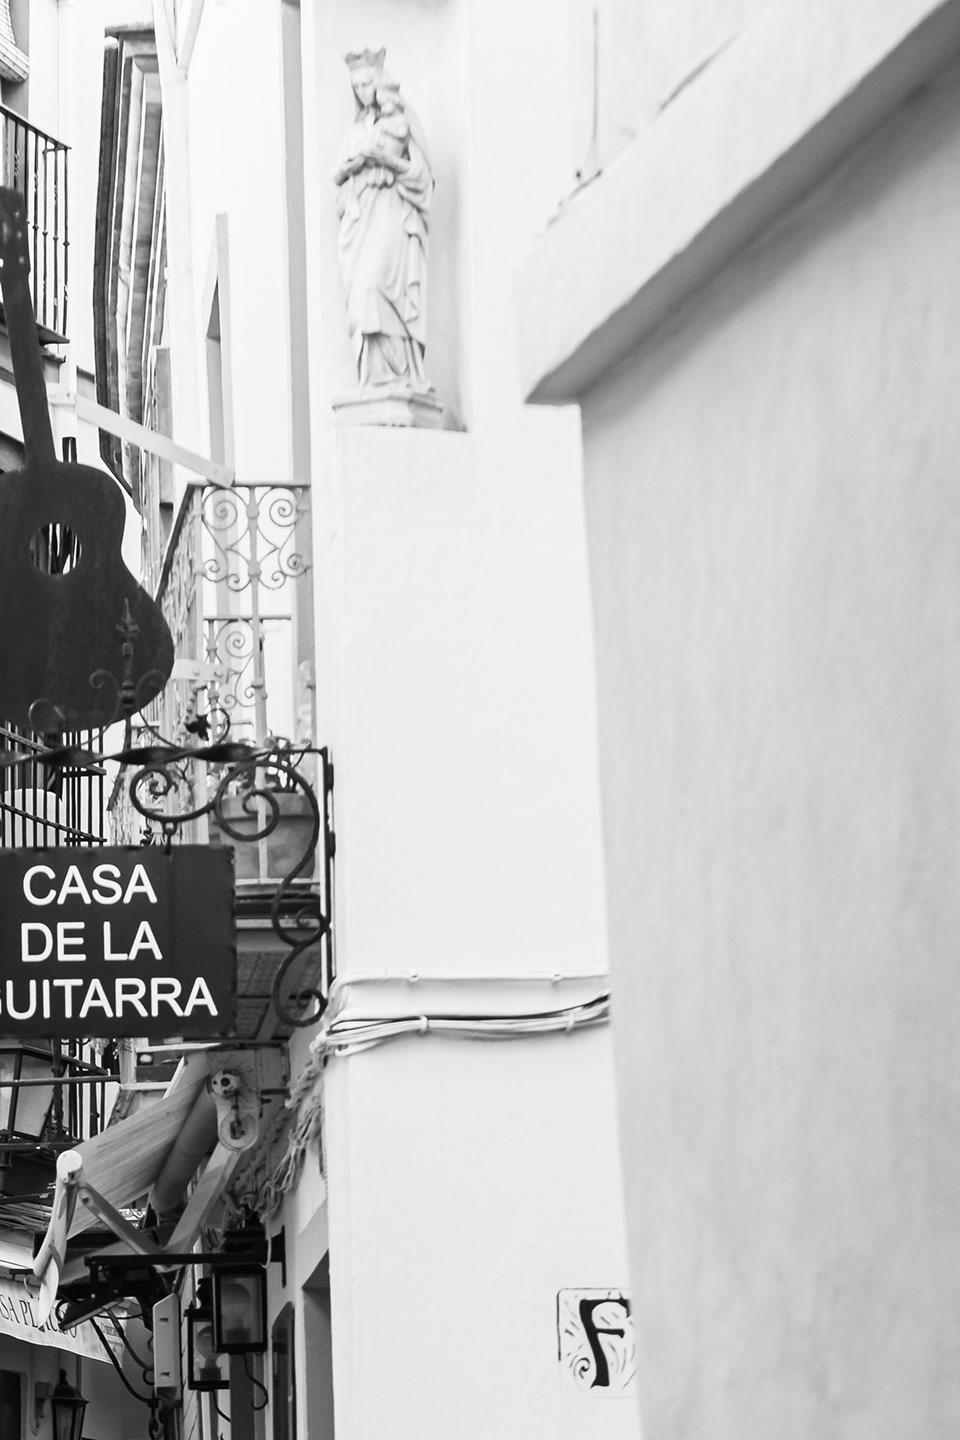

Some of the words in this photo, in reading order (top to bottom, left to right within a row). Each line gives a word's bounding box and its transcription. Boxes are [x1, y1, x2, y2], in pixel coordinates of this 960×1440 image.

[22, 863, 158, 907] CASA
[21, 922, 87, 963] DE
[103, 921, 163, 963] LA
